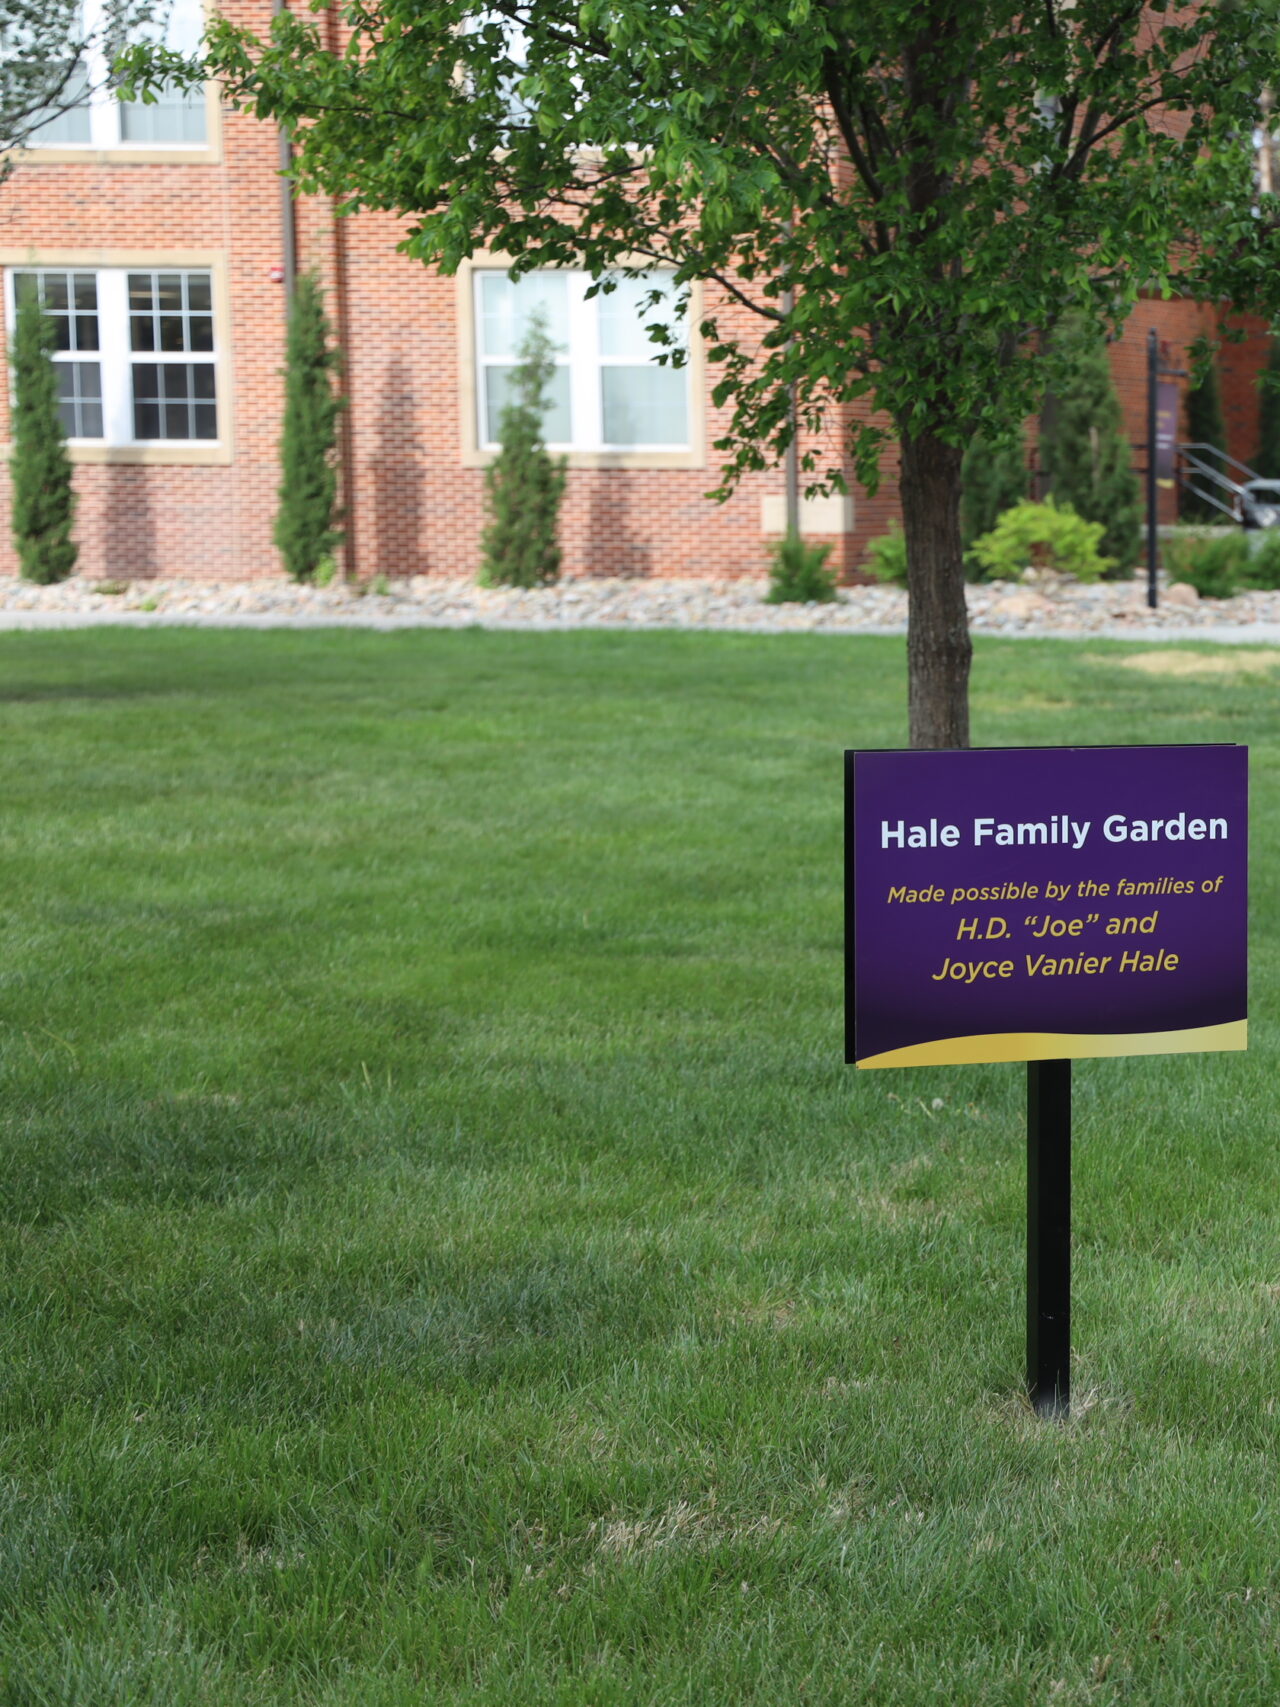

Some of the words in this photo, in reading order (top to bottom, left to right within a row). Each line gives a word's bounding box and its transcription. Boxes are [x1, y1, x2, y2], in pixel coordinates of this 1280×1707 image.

[882, 819, 960, 848] Hale
[974, 815, 1091, 849] Family
[1103, 812, 1227, 842] Garden
[888, 885, 945, 903] Made
[951, 882, 1038, 904] possible
[1045, 881, 1071, 901] by
[1078, 879, 1110, 897] the
[1116, 877, 1194, 895] families
[1202, 876, 1225, 893] of
[956, 917, 1011, 940] H.D.
[1106, 911, 1158, 934] and
[932, 958, 1014, 983] Joyce
[1026, 952, 1112, 976] Vanier
[1119, 949, 1178, 972] Hale
